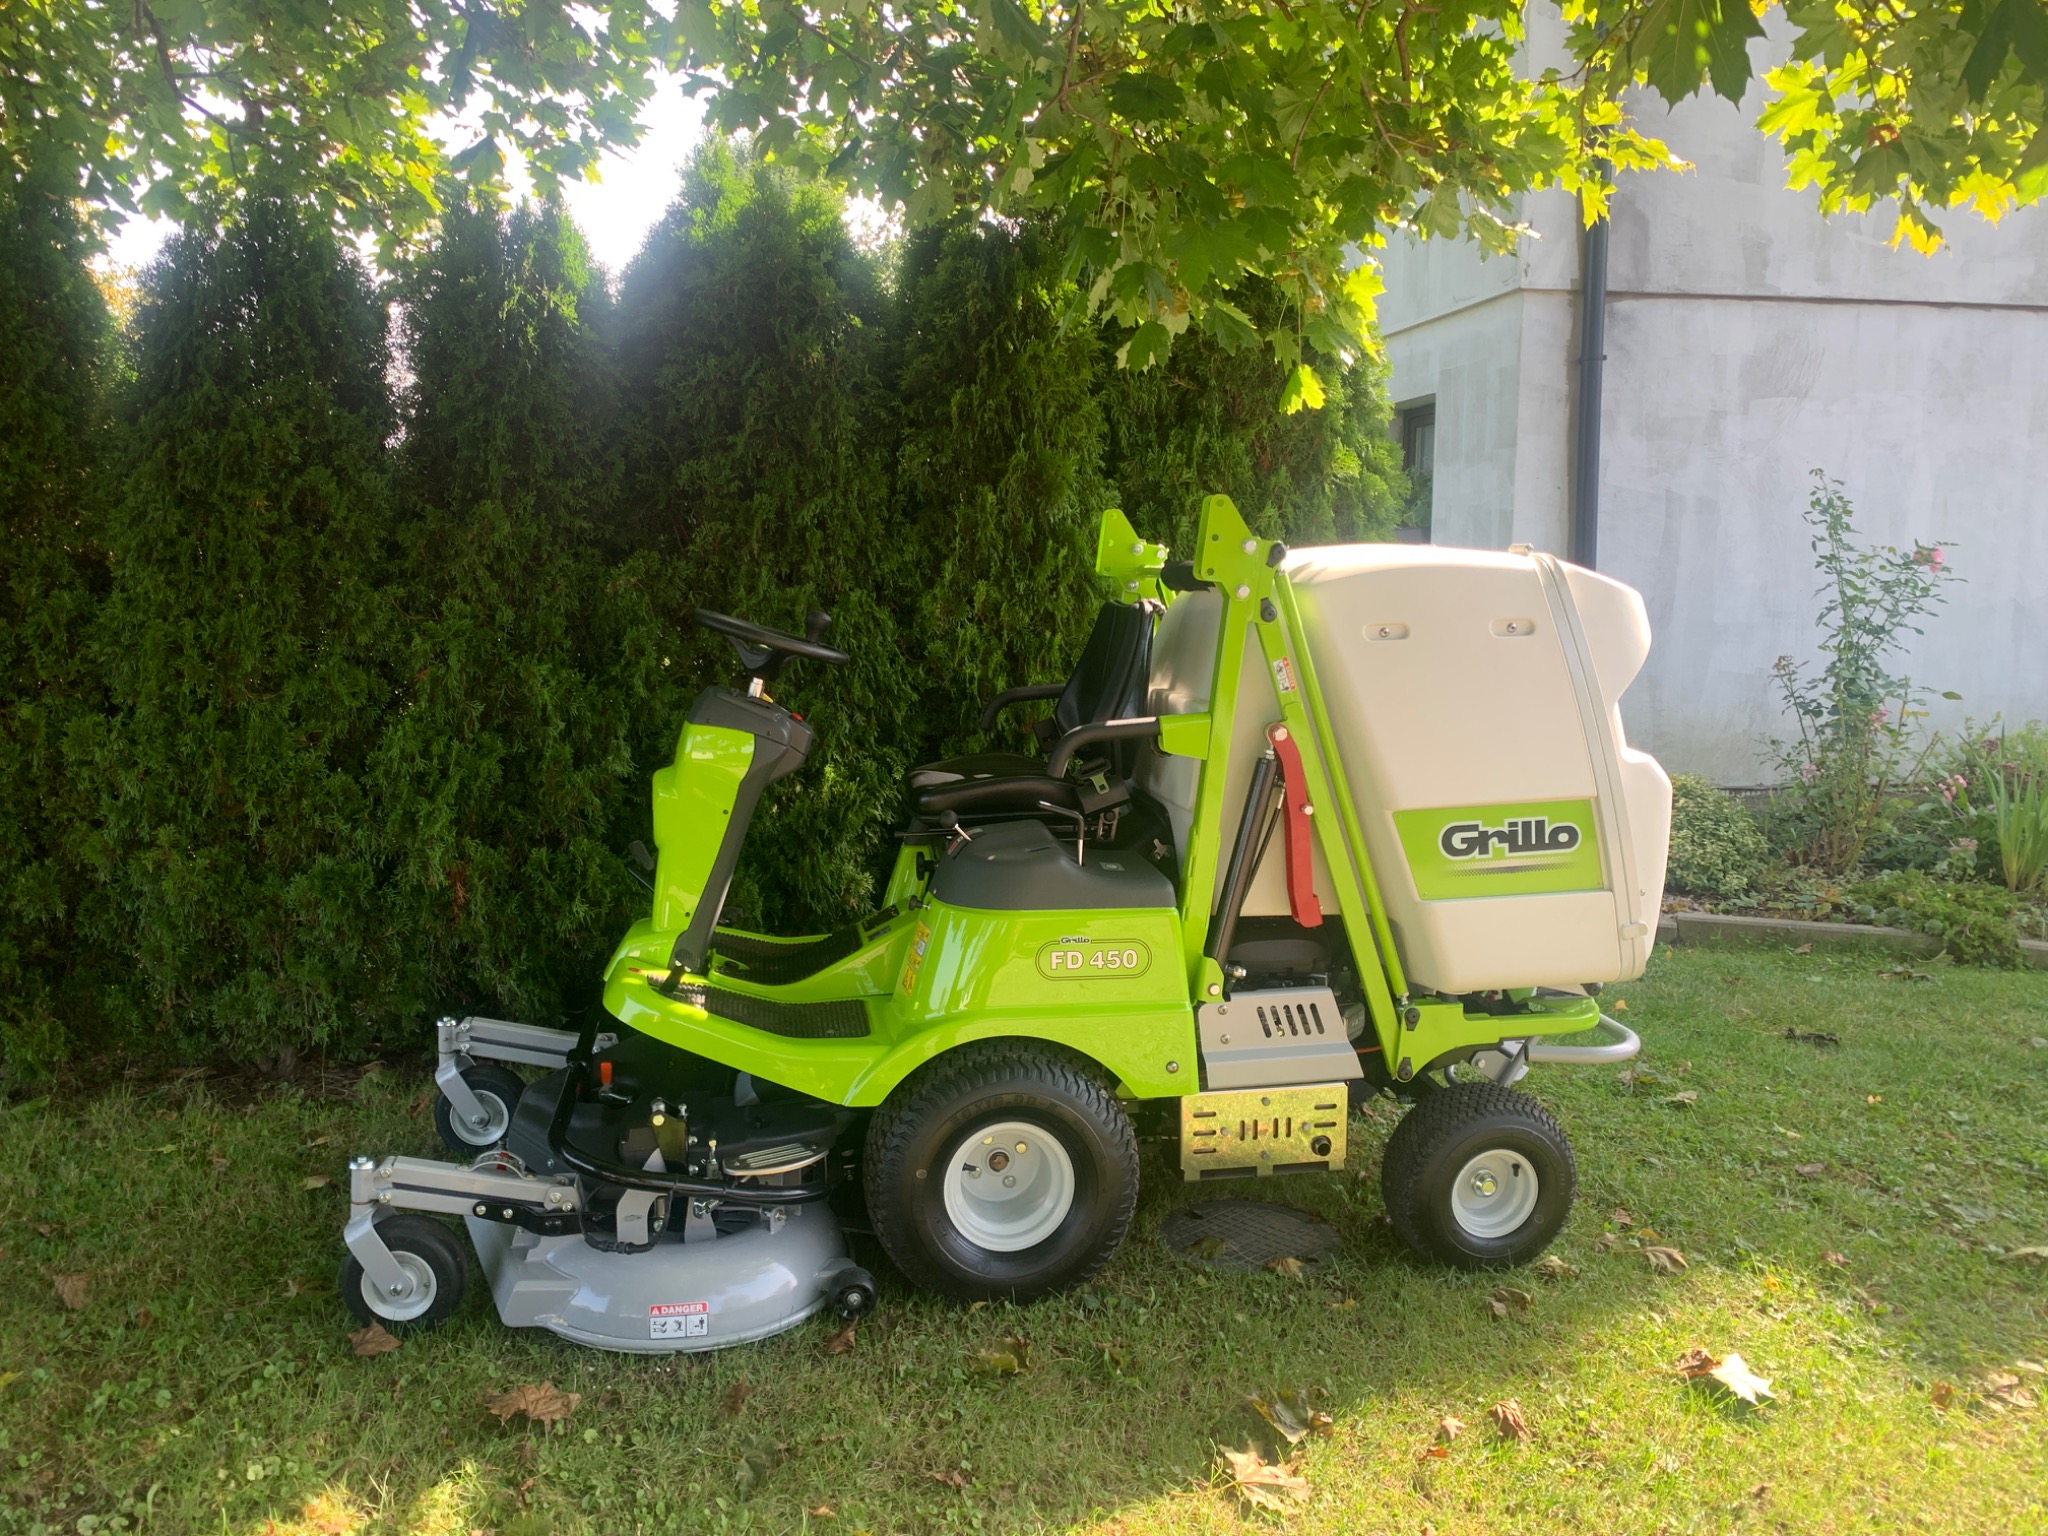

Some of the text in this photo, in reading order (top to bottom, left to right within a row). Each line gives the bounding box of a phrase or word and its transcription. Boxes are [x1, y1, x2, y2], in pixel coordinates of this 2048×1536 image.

[1440, 818, 1580, 858] Grillo
[1060, 936, 1091, 944] Grillo
[1049, 948, 1138, 970] FD 450
[661, 1304, 703, 1314] DANGER
